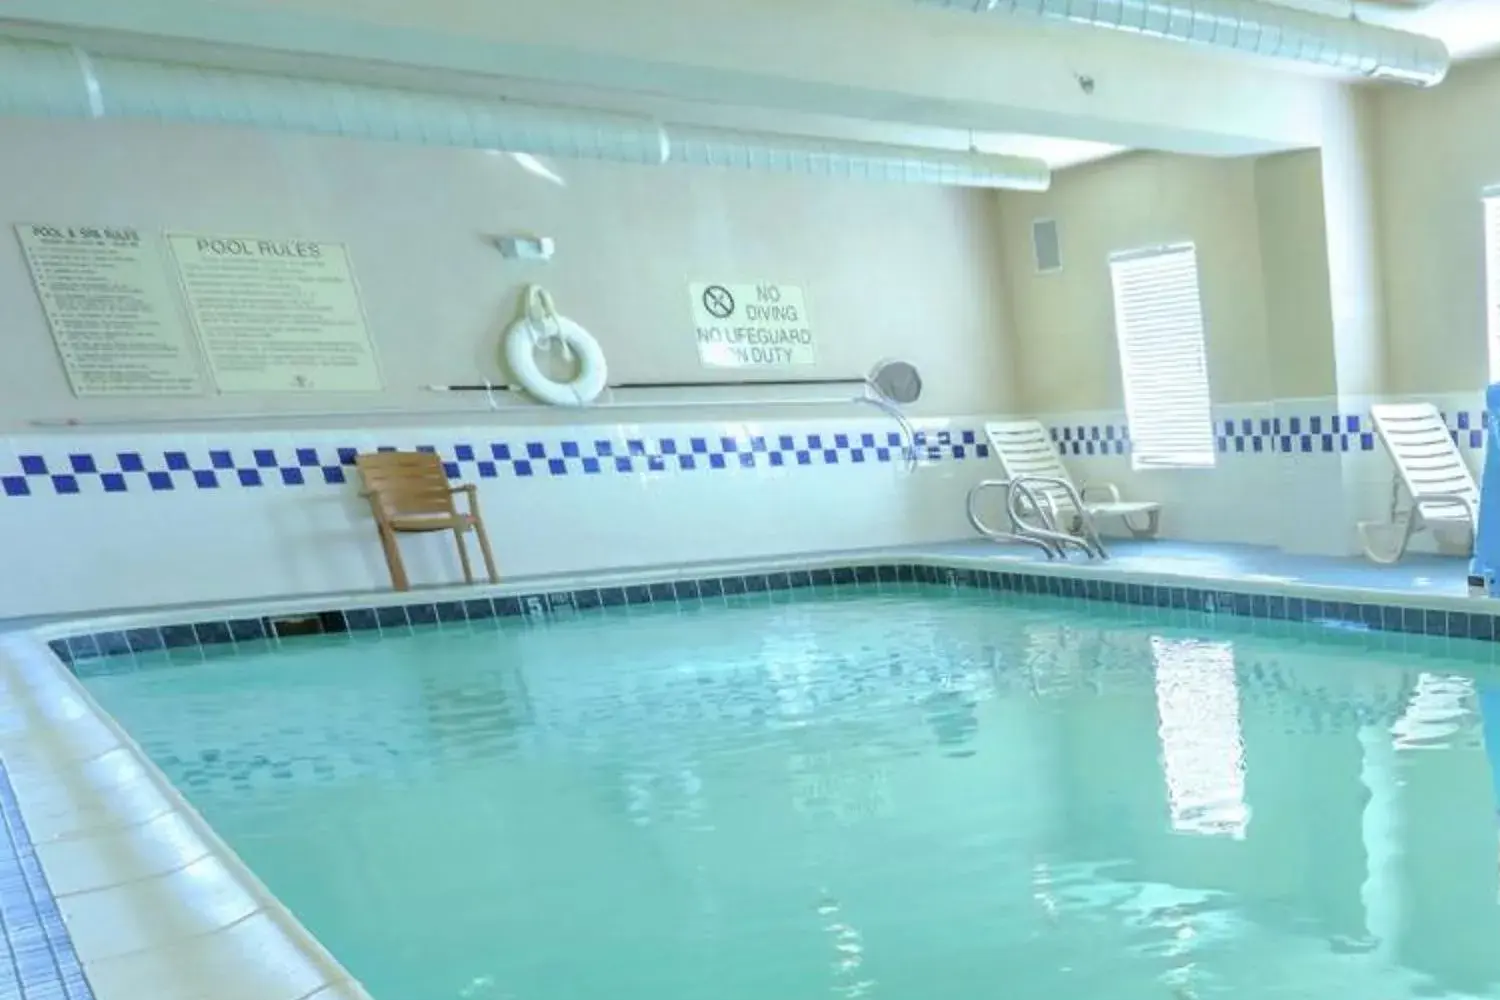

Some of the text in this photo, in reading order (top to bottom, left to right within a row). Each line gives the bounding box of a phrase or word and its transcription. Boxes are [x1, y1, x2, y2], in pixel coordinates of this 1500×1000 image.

[196, 237, 322, 258] POOL RULES
[755, 283, 781, 302] NO
[745, 304, 798, 322] DIVING
[696, 327, 812, 345] NO LIFEGUARD
[751, 346, 793, 363] DUTY
